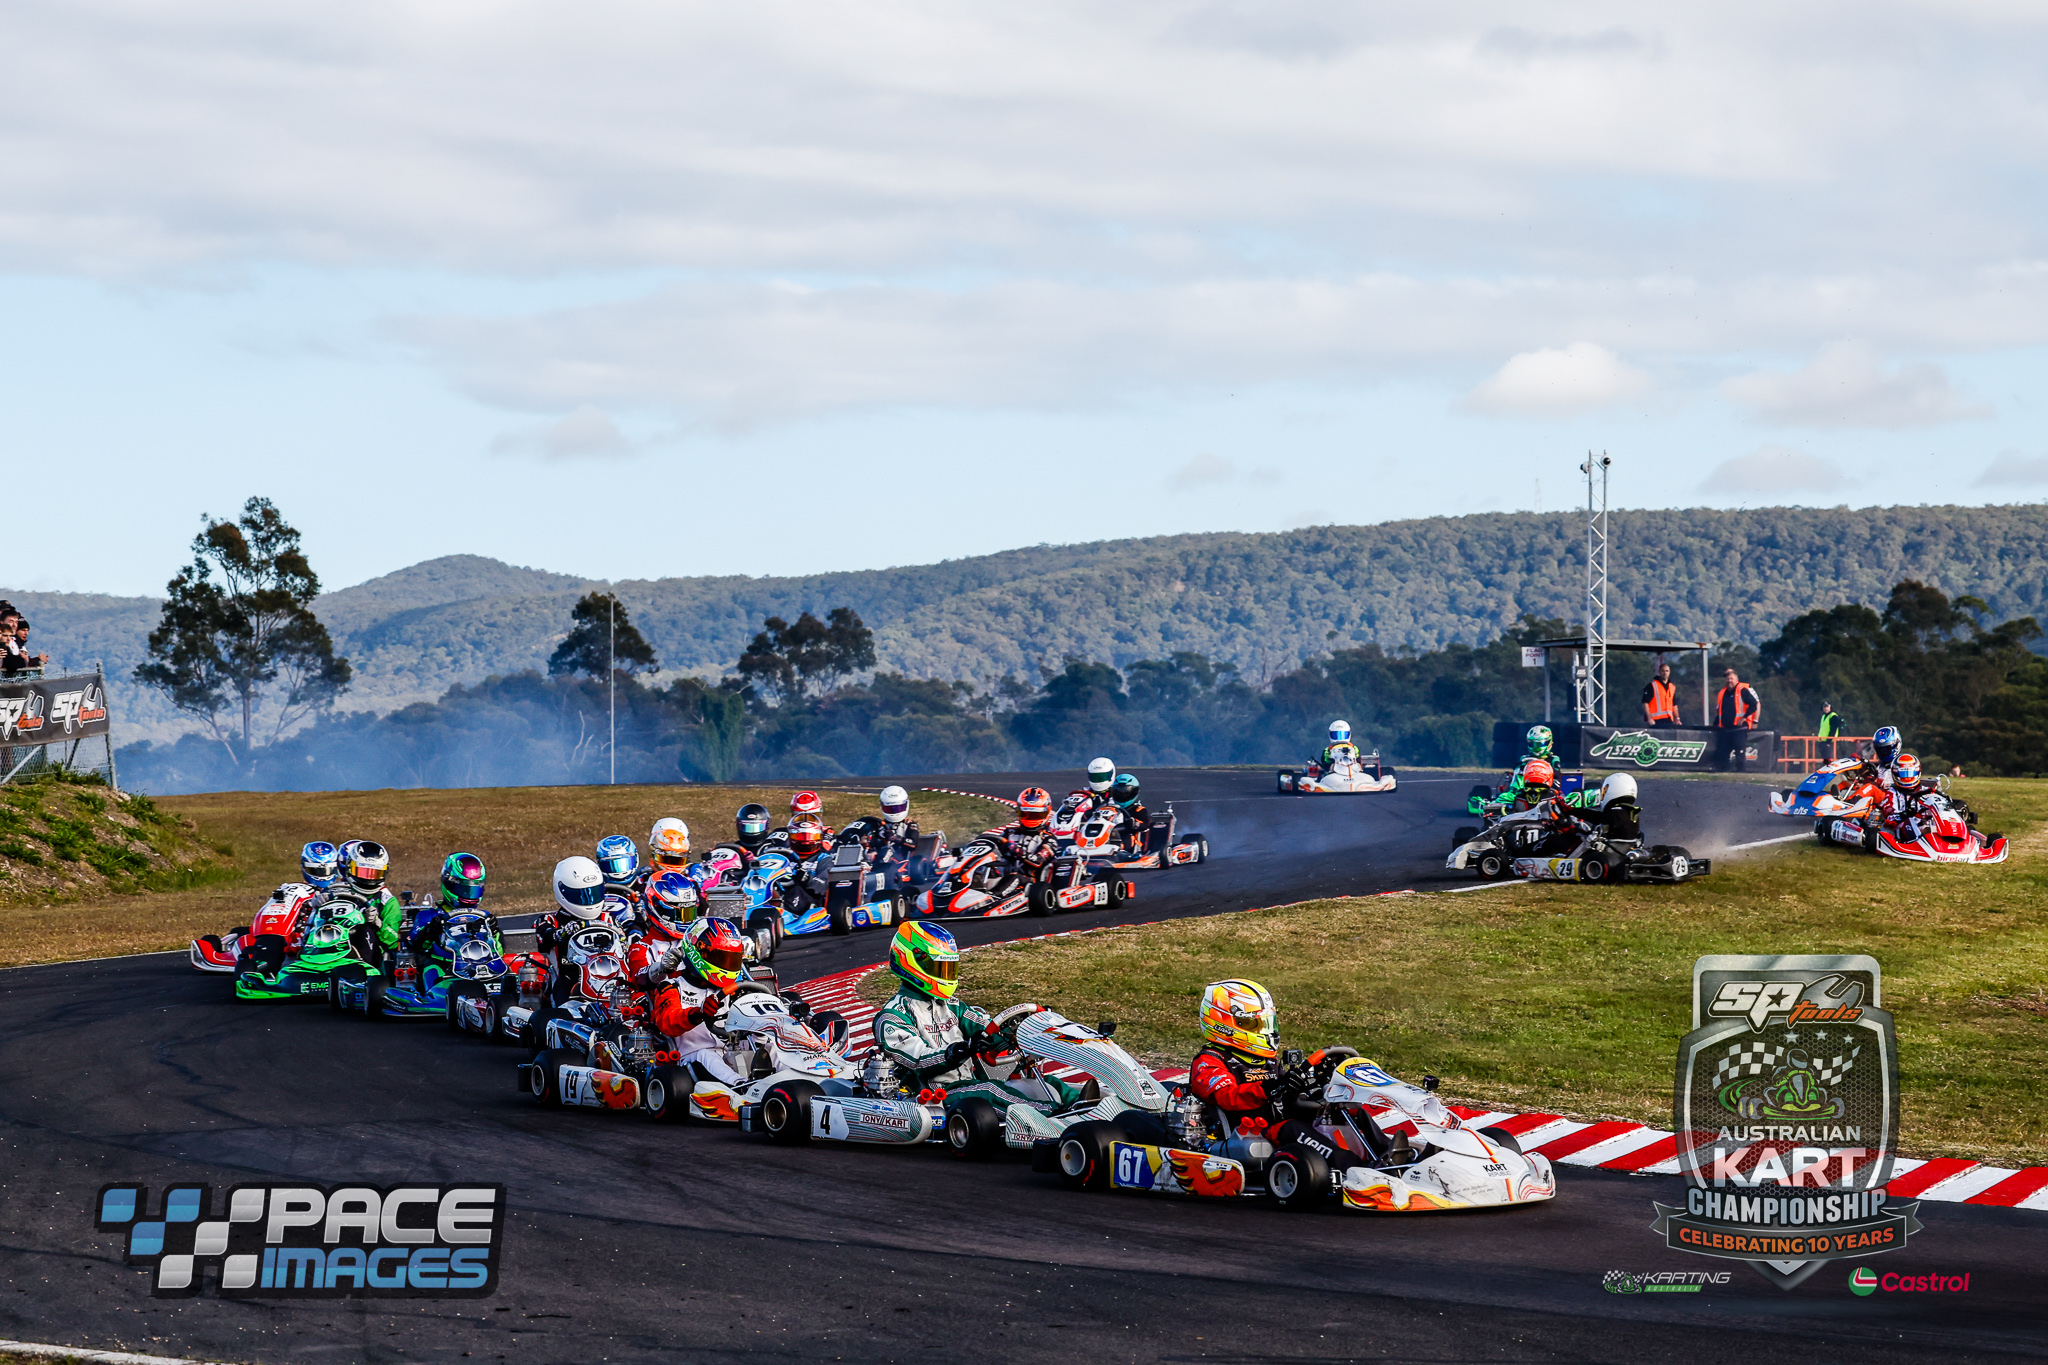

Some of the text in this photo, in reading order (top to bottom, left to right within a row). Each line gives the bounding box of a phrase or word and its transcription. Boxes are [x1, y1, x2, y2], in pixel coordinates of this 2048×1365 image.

[1559, 862, 1573, 876] 29
[1675, 861, 1686, 873] 29
[687, 951, 706, 969] AUS
[681, 996, 699, 1004] KART
[1354, 1068, 1388, 1084] 67
[564, 1070, 580, 1099] 19
[819, 1104, 832, 1135] 4
[886, 1116, 907, 1128] KART
[1296, 1132, 1333, 1159] LIAM
[1118, 1147, 1143, 1184] 67
[1482, 1163, 1508, 1172] KART
